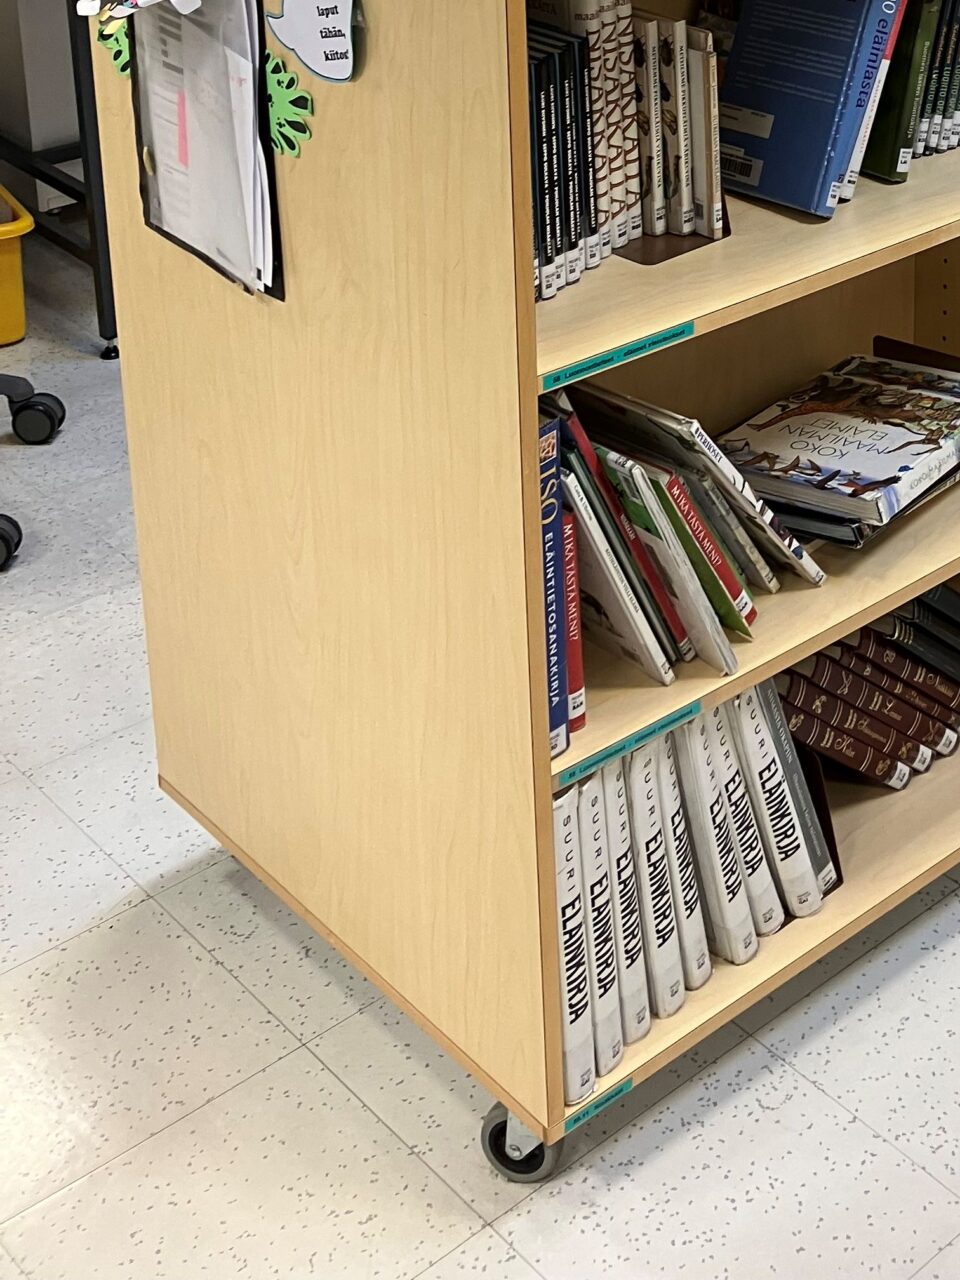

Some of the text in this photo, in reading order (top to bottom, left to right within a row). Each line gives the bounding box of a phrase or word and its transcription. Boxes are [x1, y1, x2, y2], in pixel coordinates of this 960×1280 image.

[316, 5, 339, 18] laput
[319, 27, 346, 39] tähän,
[323, 49, 349, 61] kiitos!
[855, 18, 889, 108] eläinlasta
[696, 426, 724, 463] PERHOSET
[779, 424, 890, 455] MAAILMAN
[790, 440, 849, 459] KOKO
[701, 537, 722, 567] MENI?
[544, 531, 558, 708] ELÄINTIETOSANAKIRJA
[567, 603, 579, 641] MENI?
[713, 707, 733, 770] SUURI
[643, 758, 657, 827] SUURI
[746, 695, 800, 862] SUURI ELÄINKIRJA
[616, 771, 629, 843] SUURI
[563, 814, 575, 892] SUURI
[590, 795, 603, 870] SUURI
